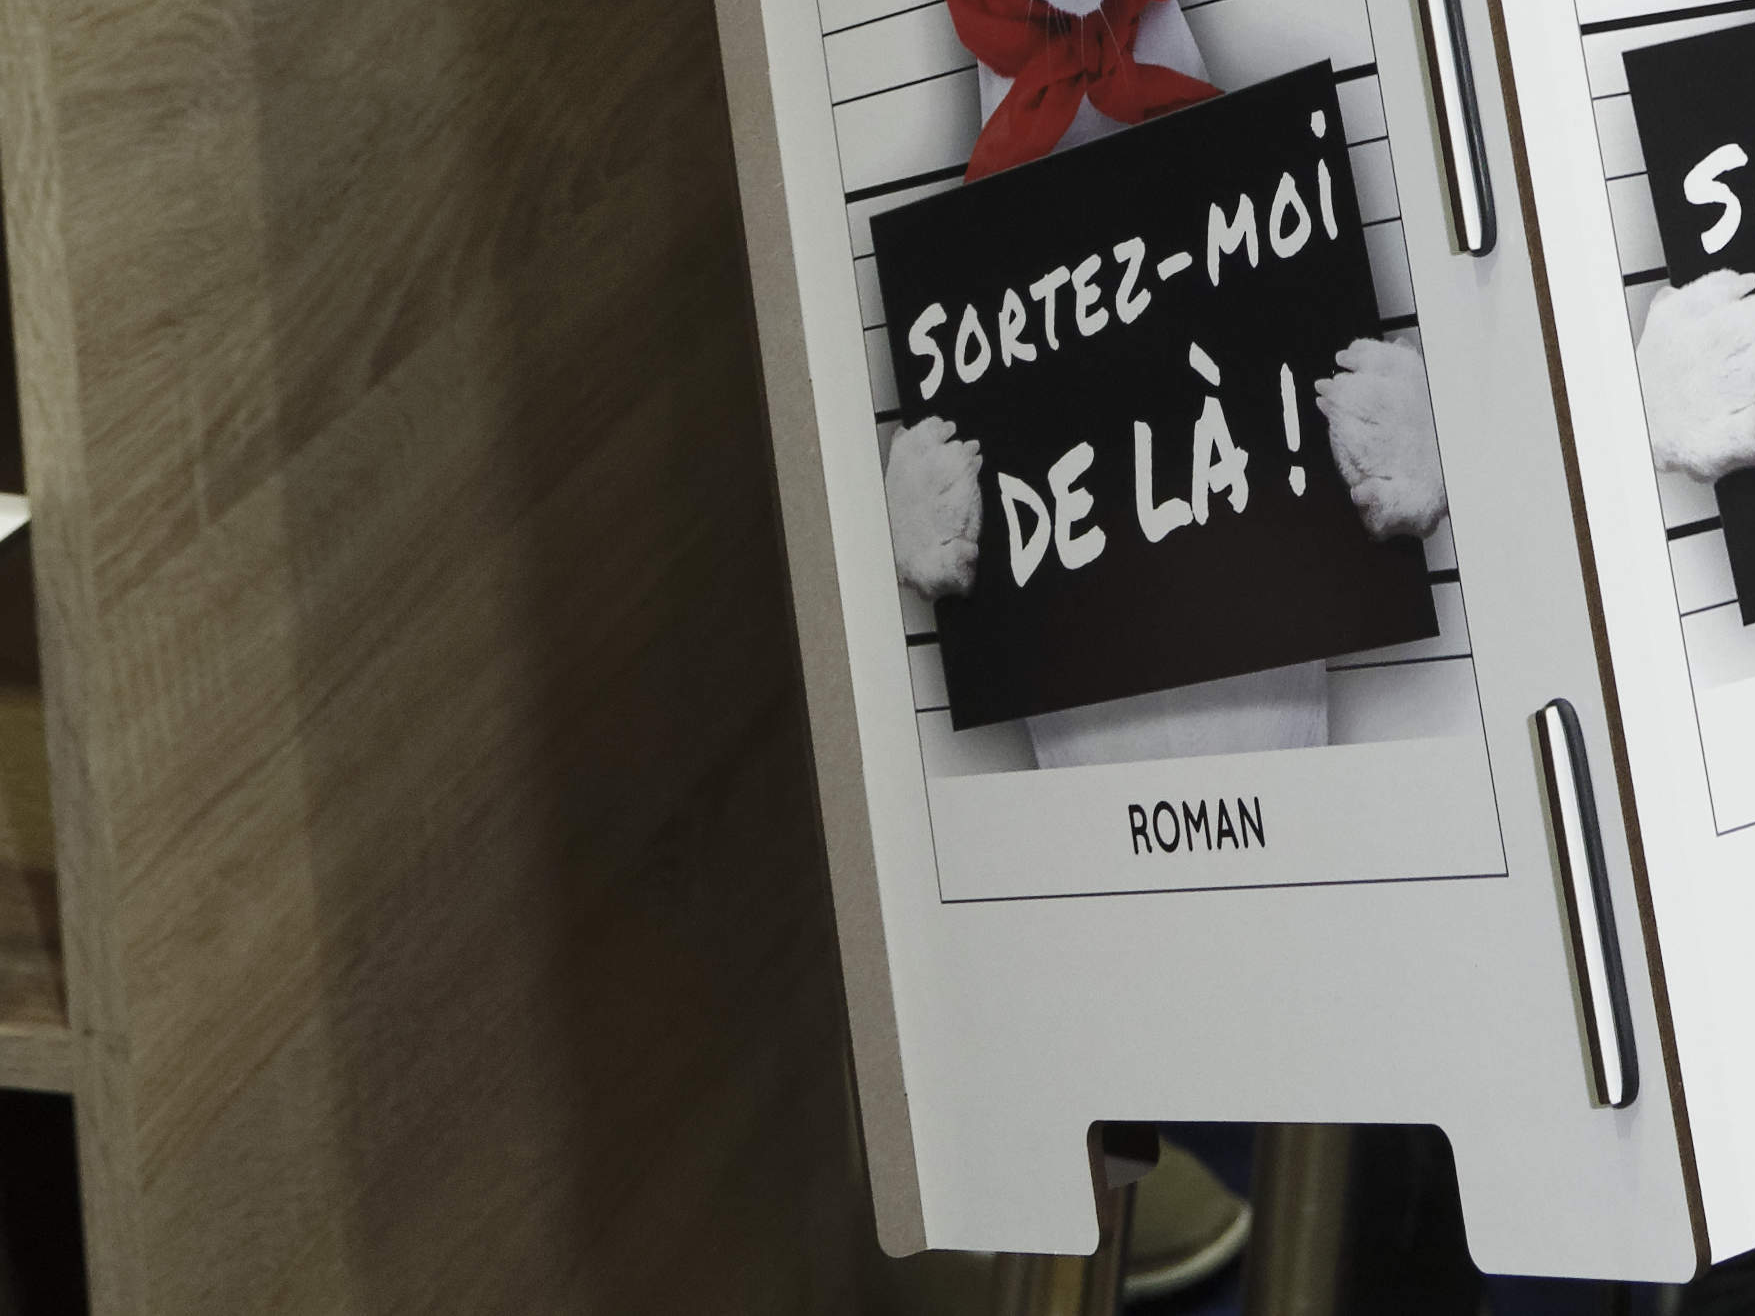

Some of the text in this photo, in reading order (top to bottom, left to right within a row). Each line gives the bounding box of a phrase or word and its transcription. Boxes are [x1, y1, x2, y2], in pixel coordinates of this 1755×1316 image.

[997, 342, 1307, 588] DE LÀ !
[1128, 796, 1266, 857] ROMAN
